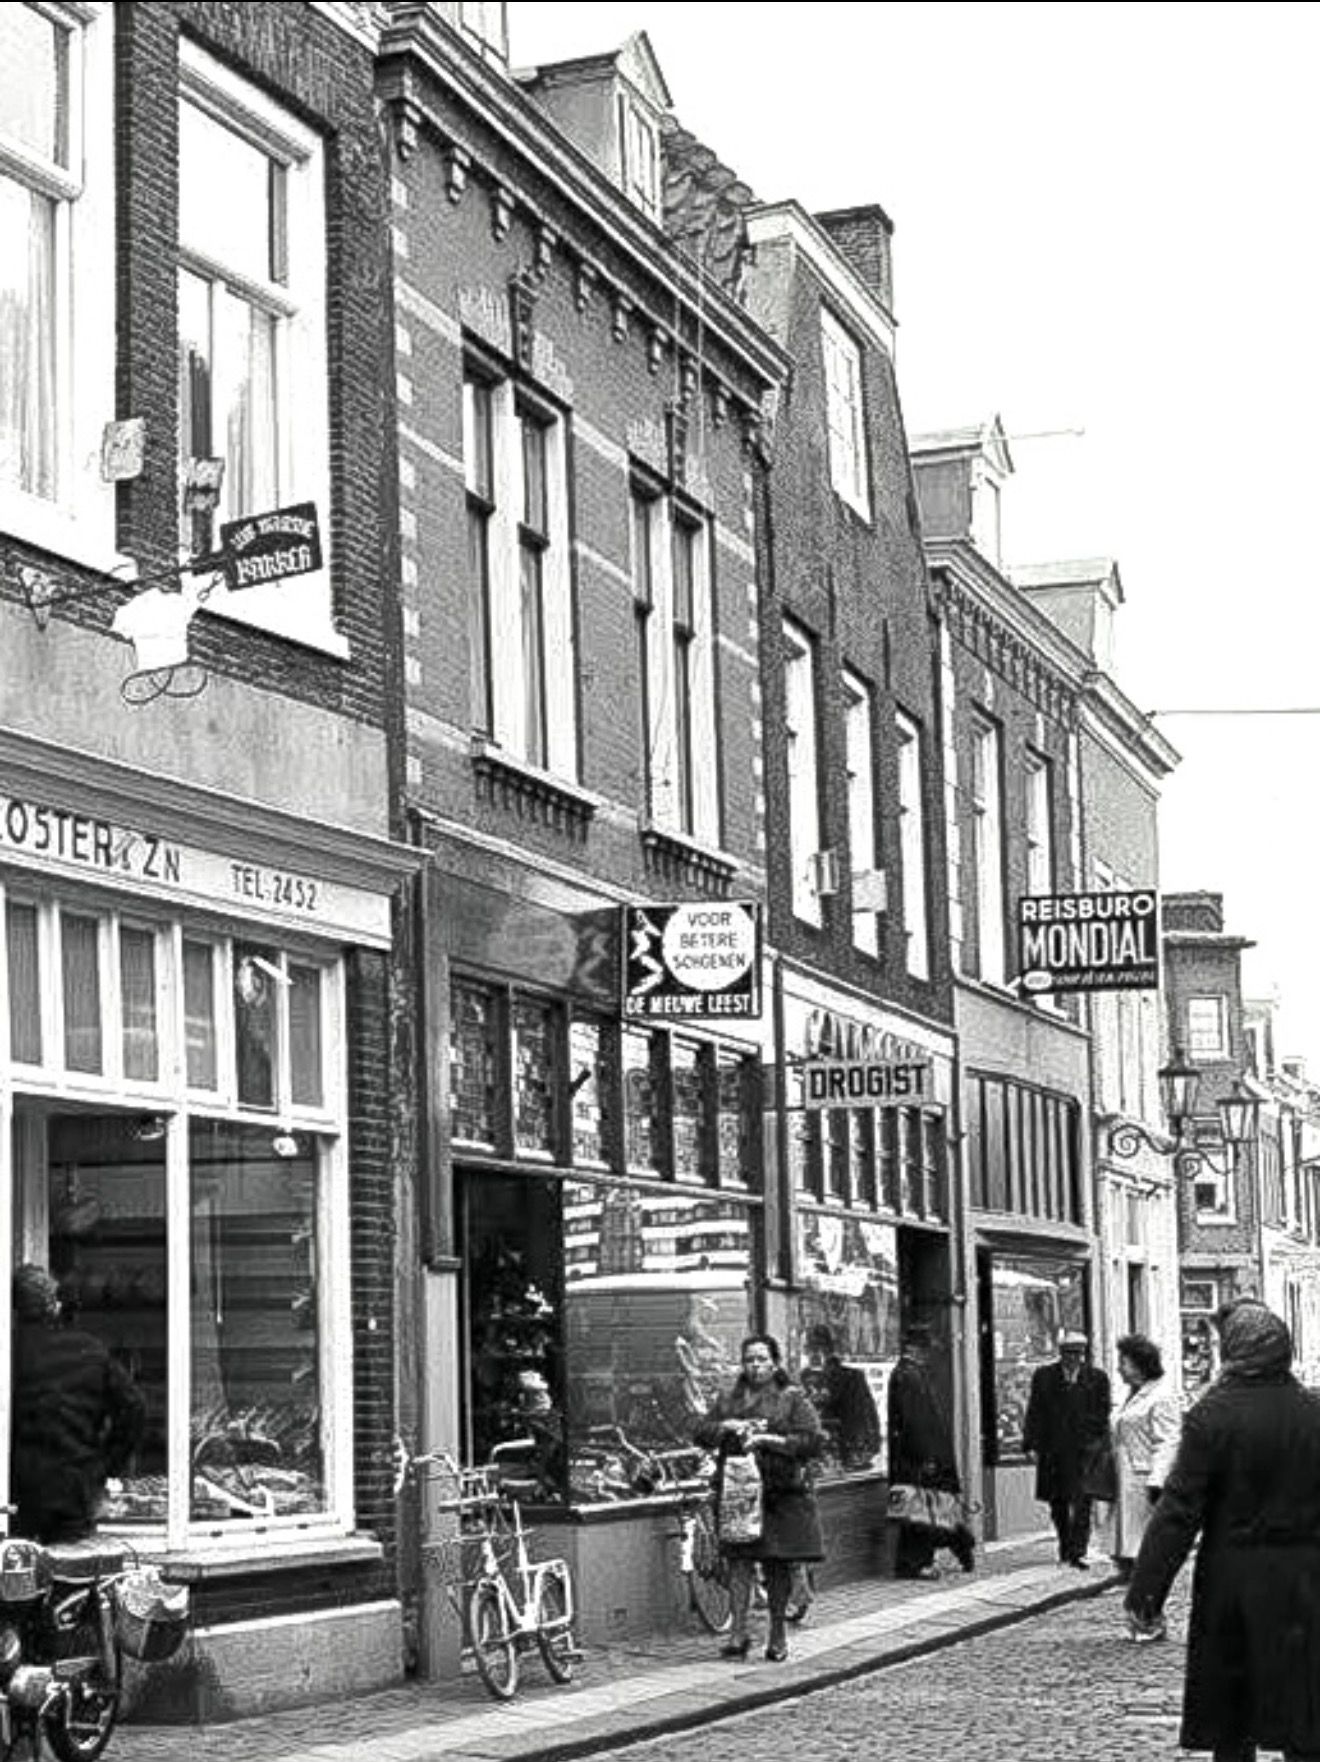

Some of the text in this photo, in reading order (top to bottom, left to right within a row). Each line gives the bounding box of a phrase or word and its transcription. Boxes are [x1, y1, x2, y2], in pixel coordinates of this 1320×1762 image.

[0, 801, 112, 866] OSTER
[143, 835, 180, 882] ZN
[688, 911, 731, 927] VOOR
[1022, 894, 1154, 921] REISBURO
[680, 932, 737, 949] BETERE
[1022, 920, 1155, 970] MONDIAL
[672, 953, 746, 970] SCHOENEN
[626, 995, 646, 1015] DE
[707, 993, 750, 1014] LEEST
[810, 1063, 927, 1099] DROGIST
